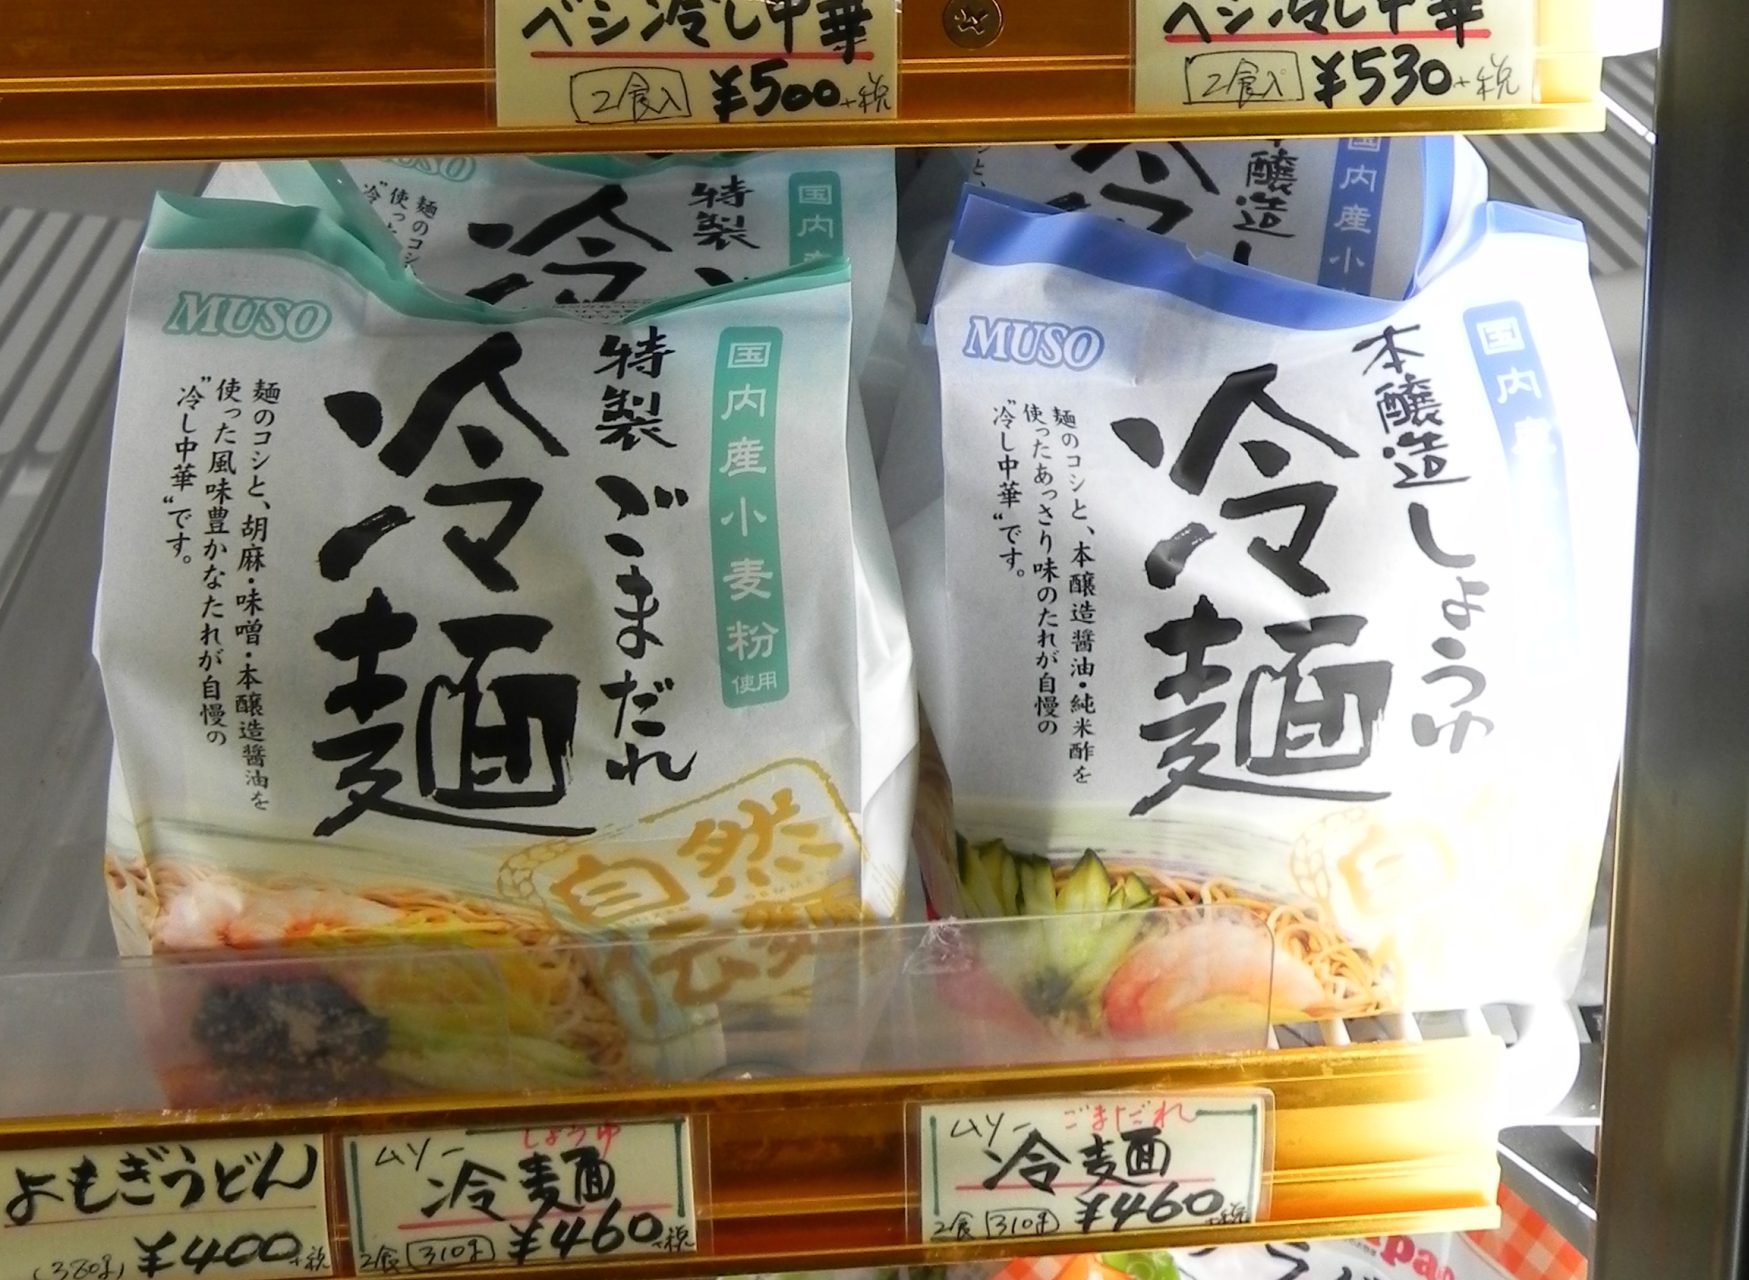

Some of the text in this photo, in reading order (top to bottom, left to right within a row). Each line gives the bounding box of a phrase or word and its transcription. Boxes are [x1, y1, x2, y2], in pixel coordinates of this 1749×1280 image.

[164, 290, 333, 342] MUSO
[963, 316, 1105, 371] MUSO
[197, 377, 242, 746] 使った風味豊かなたれが自慢の
[313, 332, 597, 837] 冷麺
[594, 326, 697, 785] 特製ごまだれ
[1022, 403, 1061, 736] 使ったあっさり味のたれが自慢の
[1111, 363, 1394, 816] 冷麺
[6, 1141, 319, 1226] よもぎうどん
